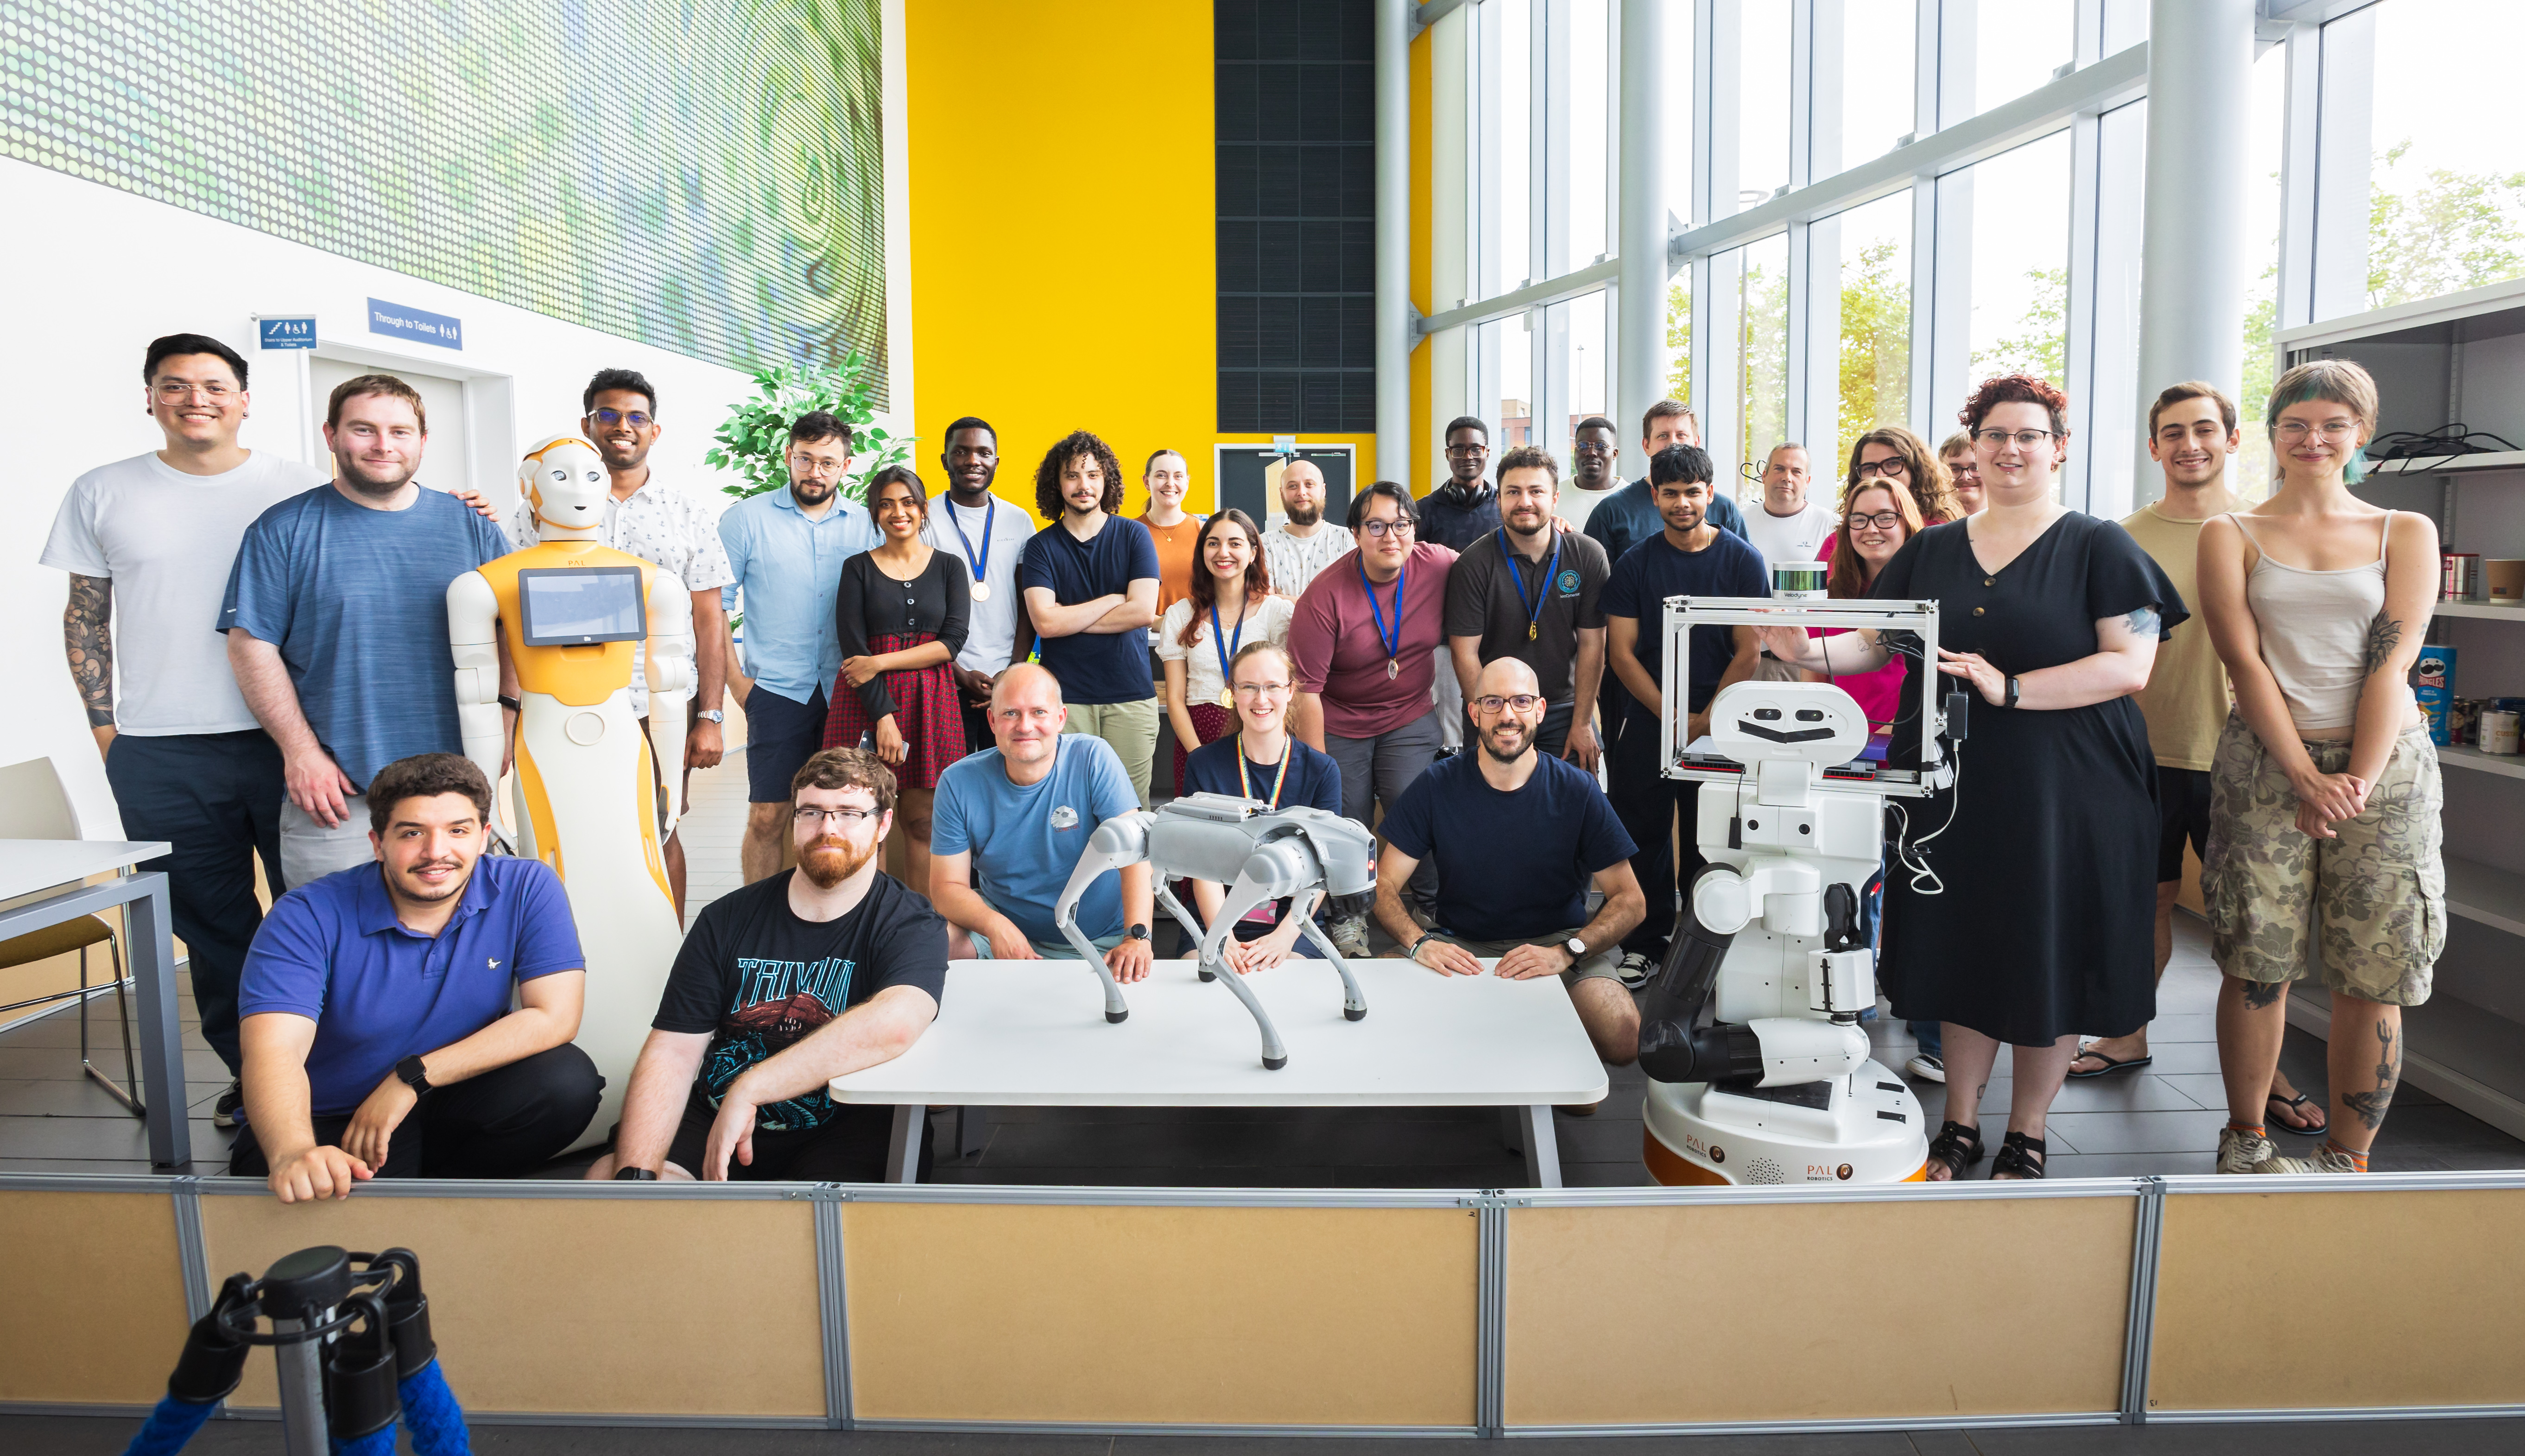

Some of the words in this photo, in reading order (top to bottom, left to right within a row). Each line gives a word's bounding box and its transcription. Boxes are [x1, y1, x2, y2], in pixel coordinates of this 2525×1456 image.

[374, 311, 404, 328] Through
[405, 319, 413, 329] to
[414, 320, 436, 334] Toilets
[2419, 677, 2444, 688] PRINGLES
[1274, 766, 1283, 787] LINCOLN
[1687, 1134, 1706, 1152] PAL
[1686, 1145, 1706, 1158] ROBOTICS
[1808, 1165, 1832, 1175] PAL
